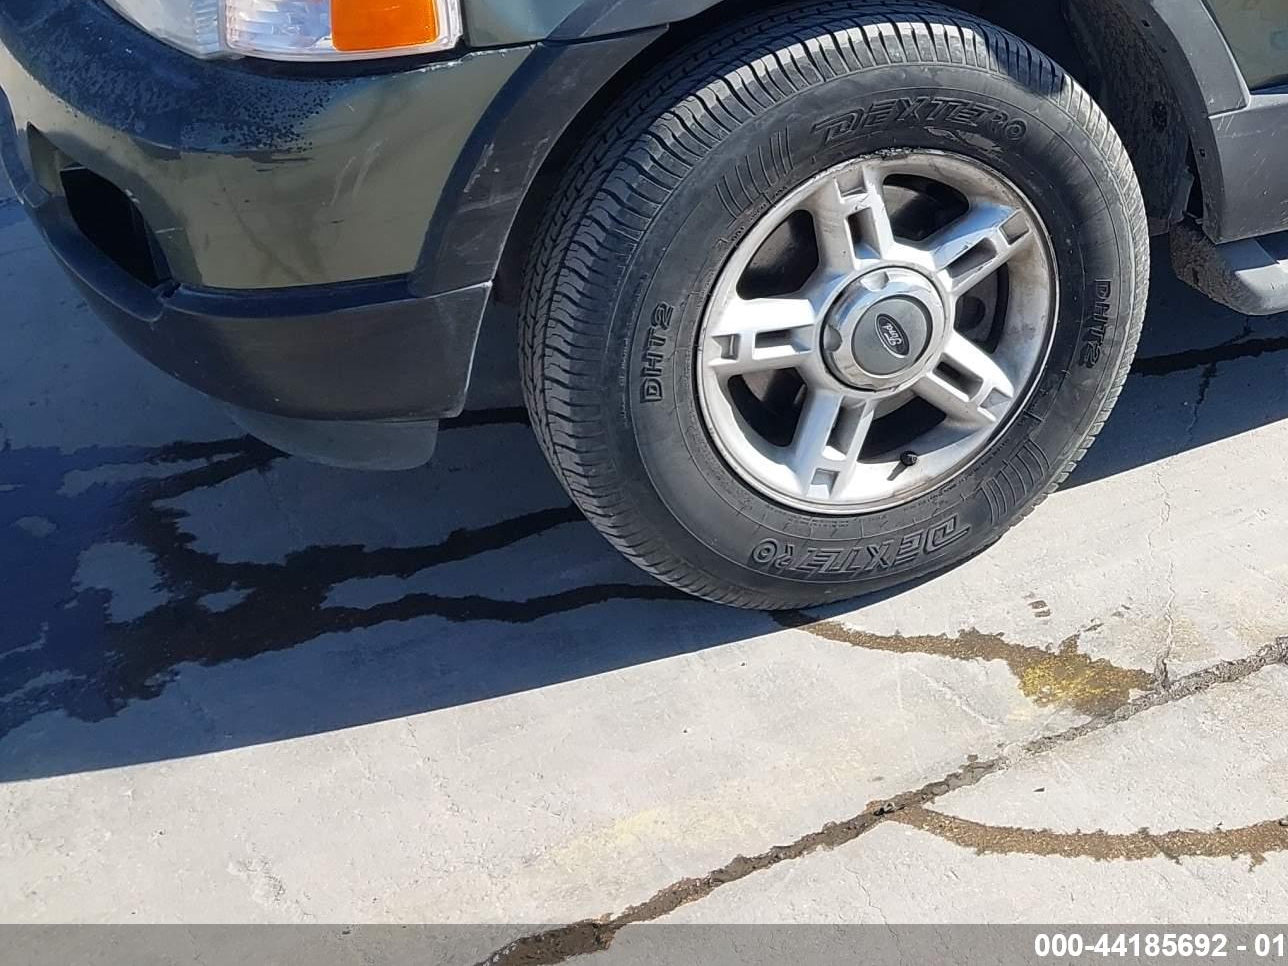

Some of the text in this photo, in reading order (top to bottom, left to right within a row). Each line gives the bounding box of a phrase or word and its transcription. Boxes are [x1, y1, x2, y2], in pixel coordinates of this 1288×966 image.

[810, 95, 1029, 146] DEXTERO
[640, 300, 675, 403] DHT2
[1078, 278, 1112, 369] DHT2
[751, 512, 971, 579] DEXTERO
